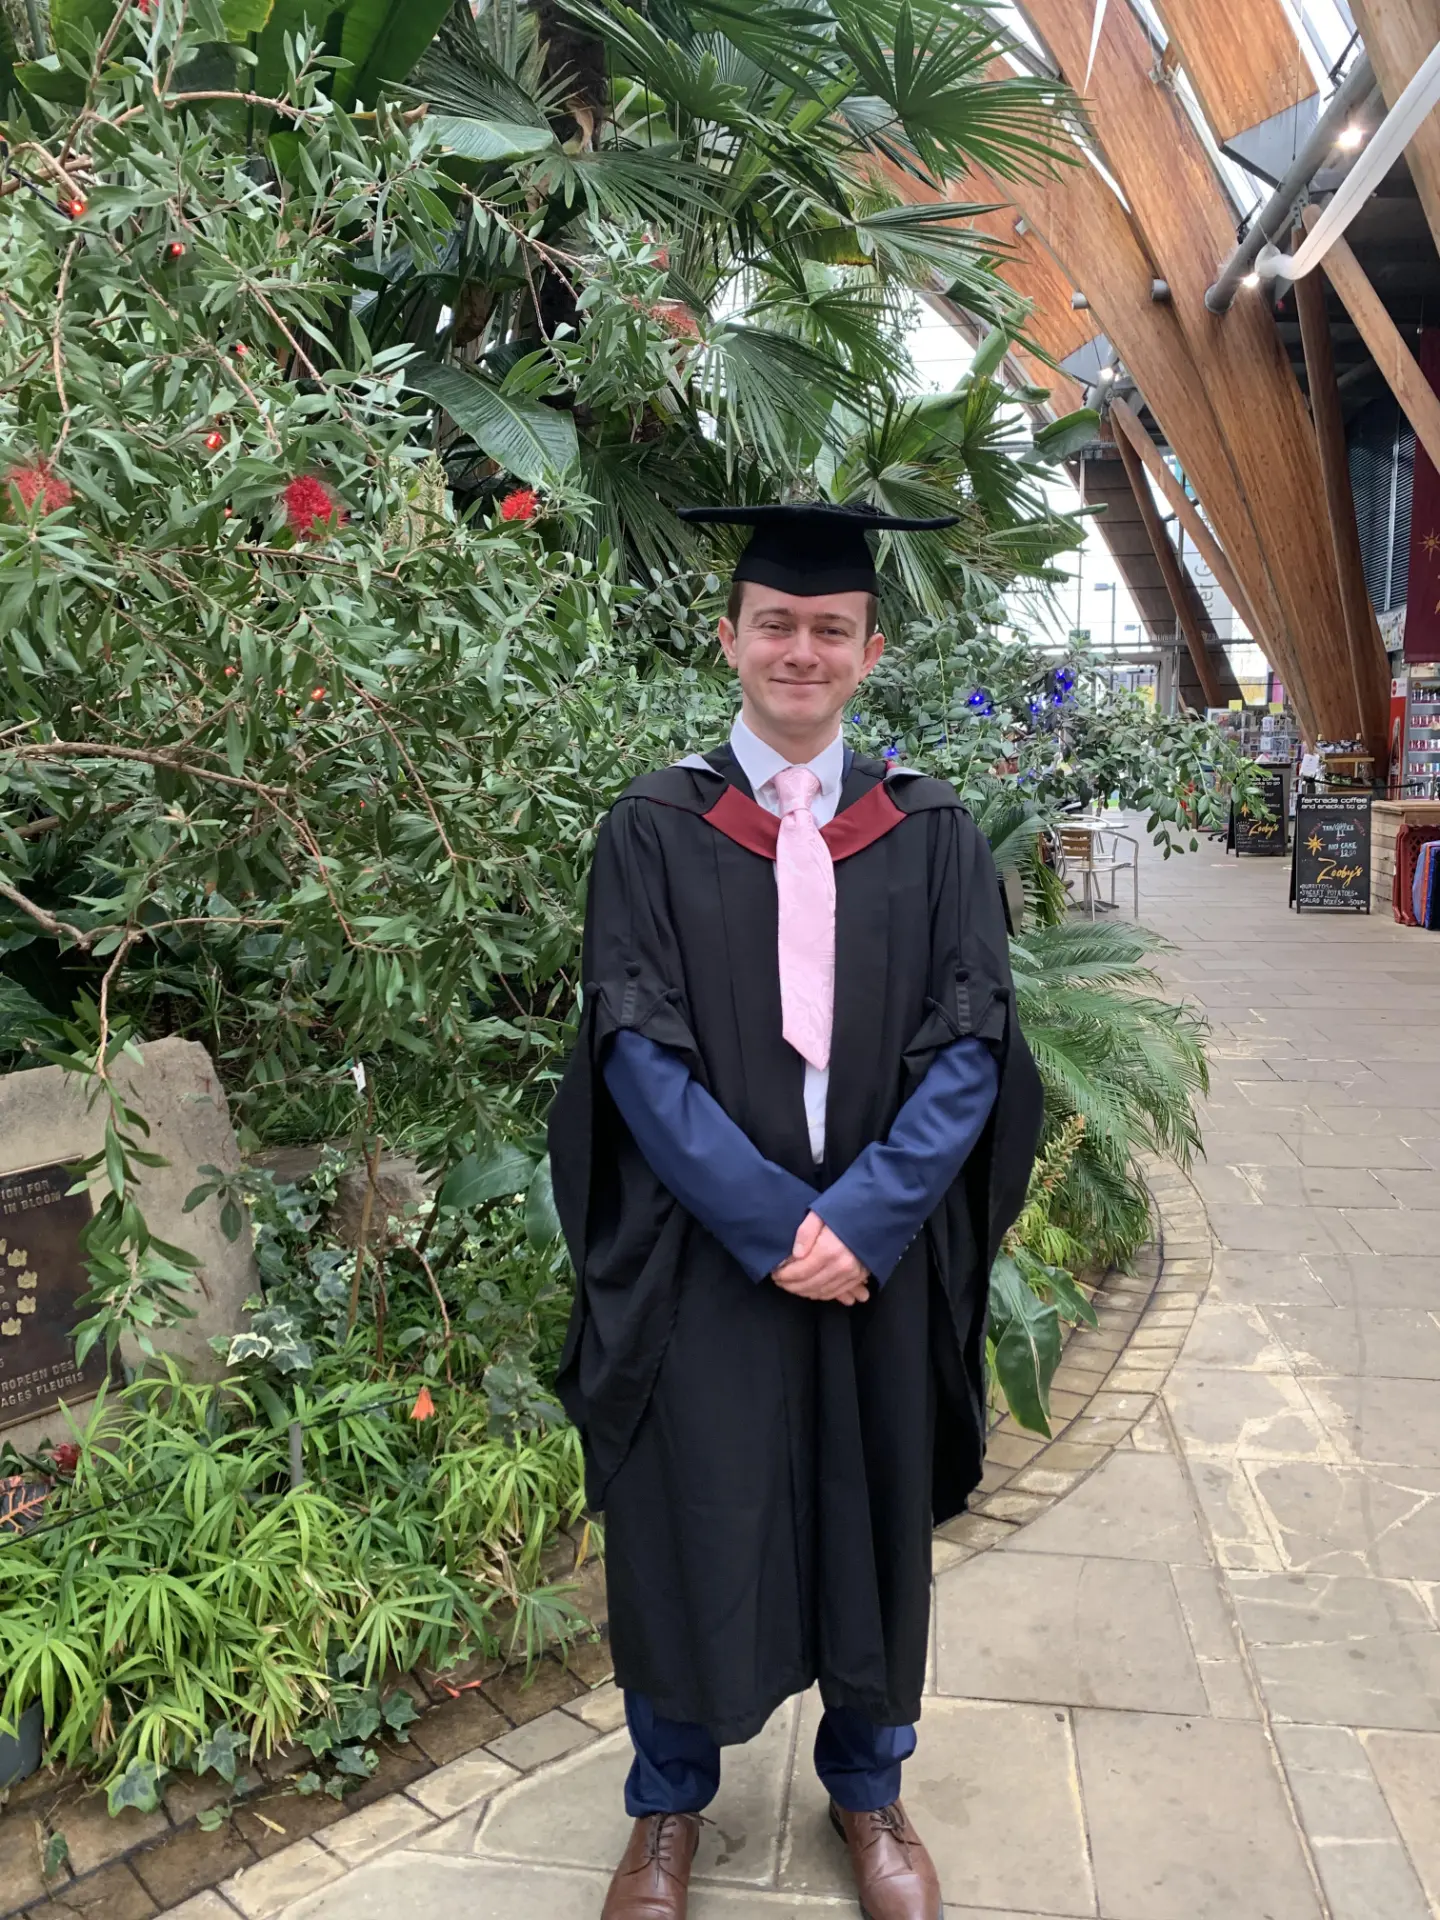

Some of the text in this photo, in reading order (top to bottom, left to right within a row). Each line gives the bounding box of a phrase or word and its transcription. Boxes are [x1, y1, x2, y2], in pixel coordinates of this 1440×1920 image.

[26, 1179, 50, 1194] FOR
[3, 1190, 61, 1215] IN BLOOM
[51, 1360, 75, 1375] DES
[36, 1371, 84, 1396] FLEURIS
